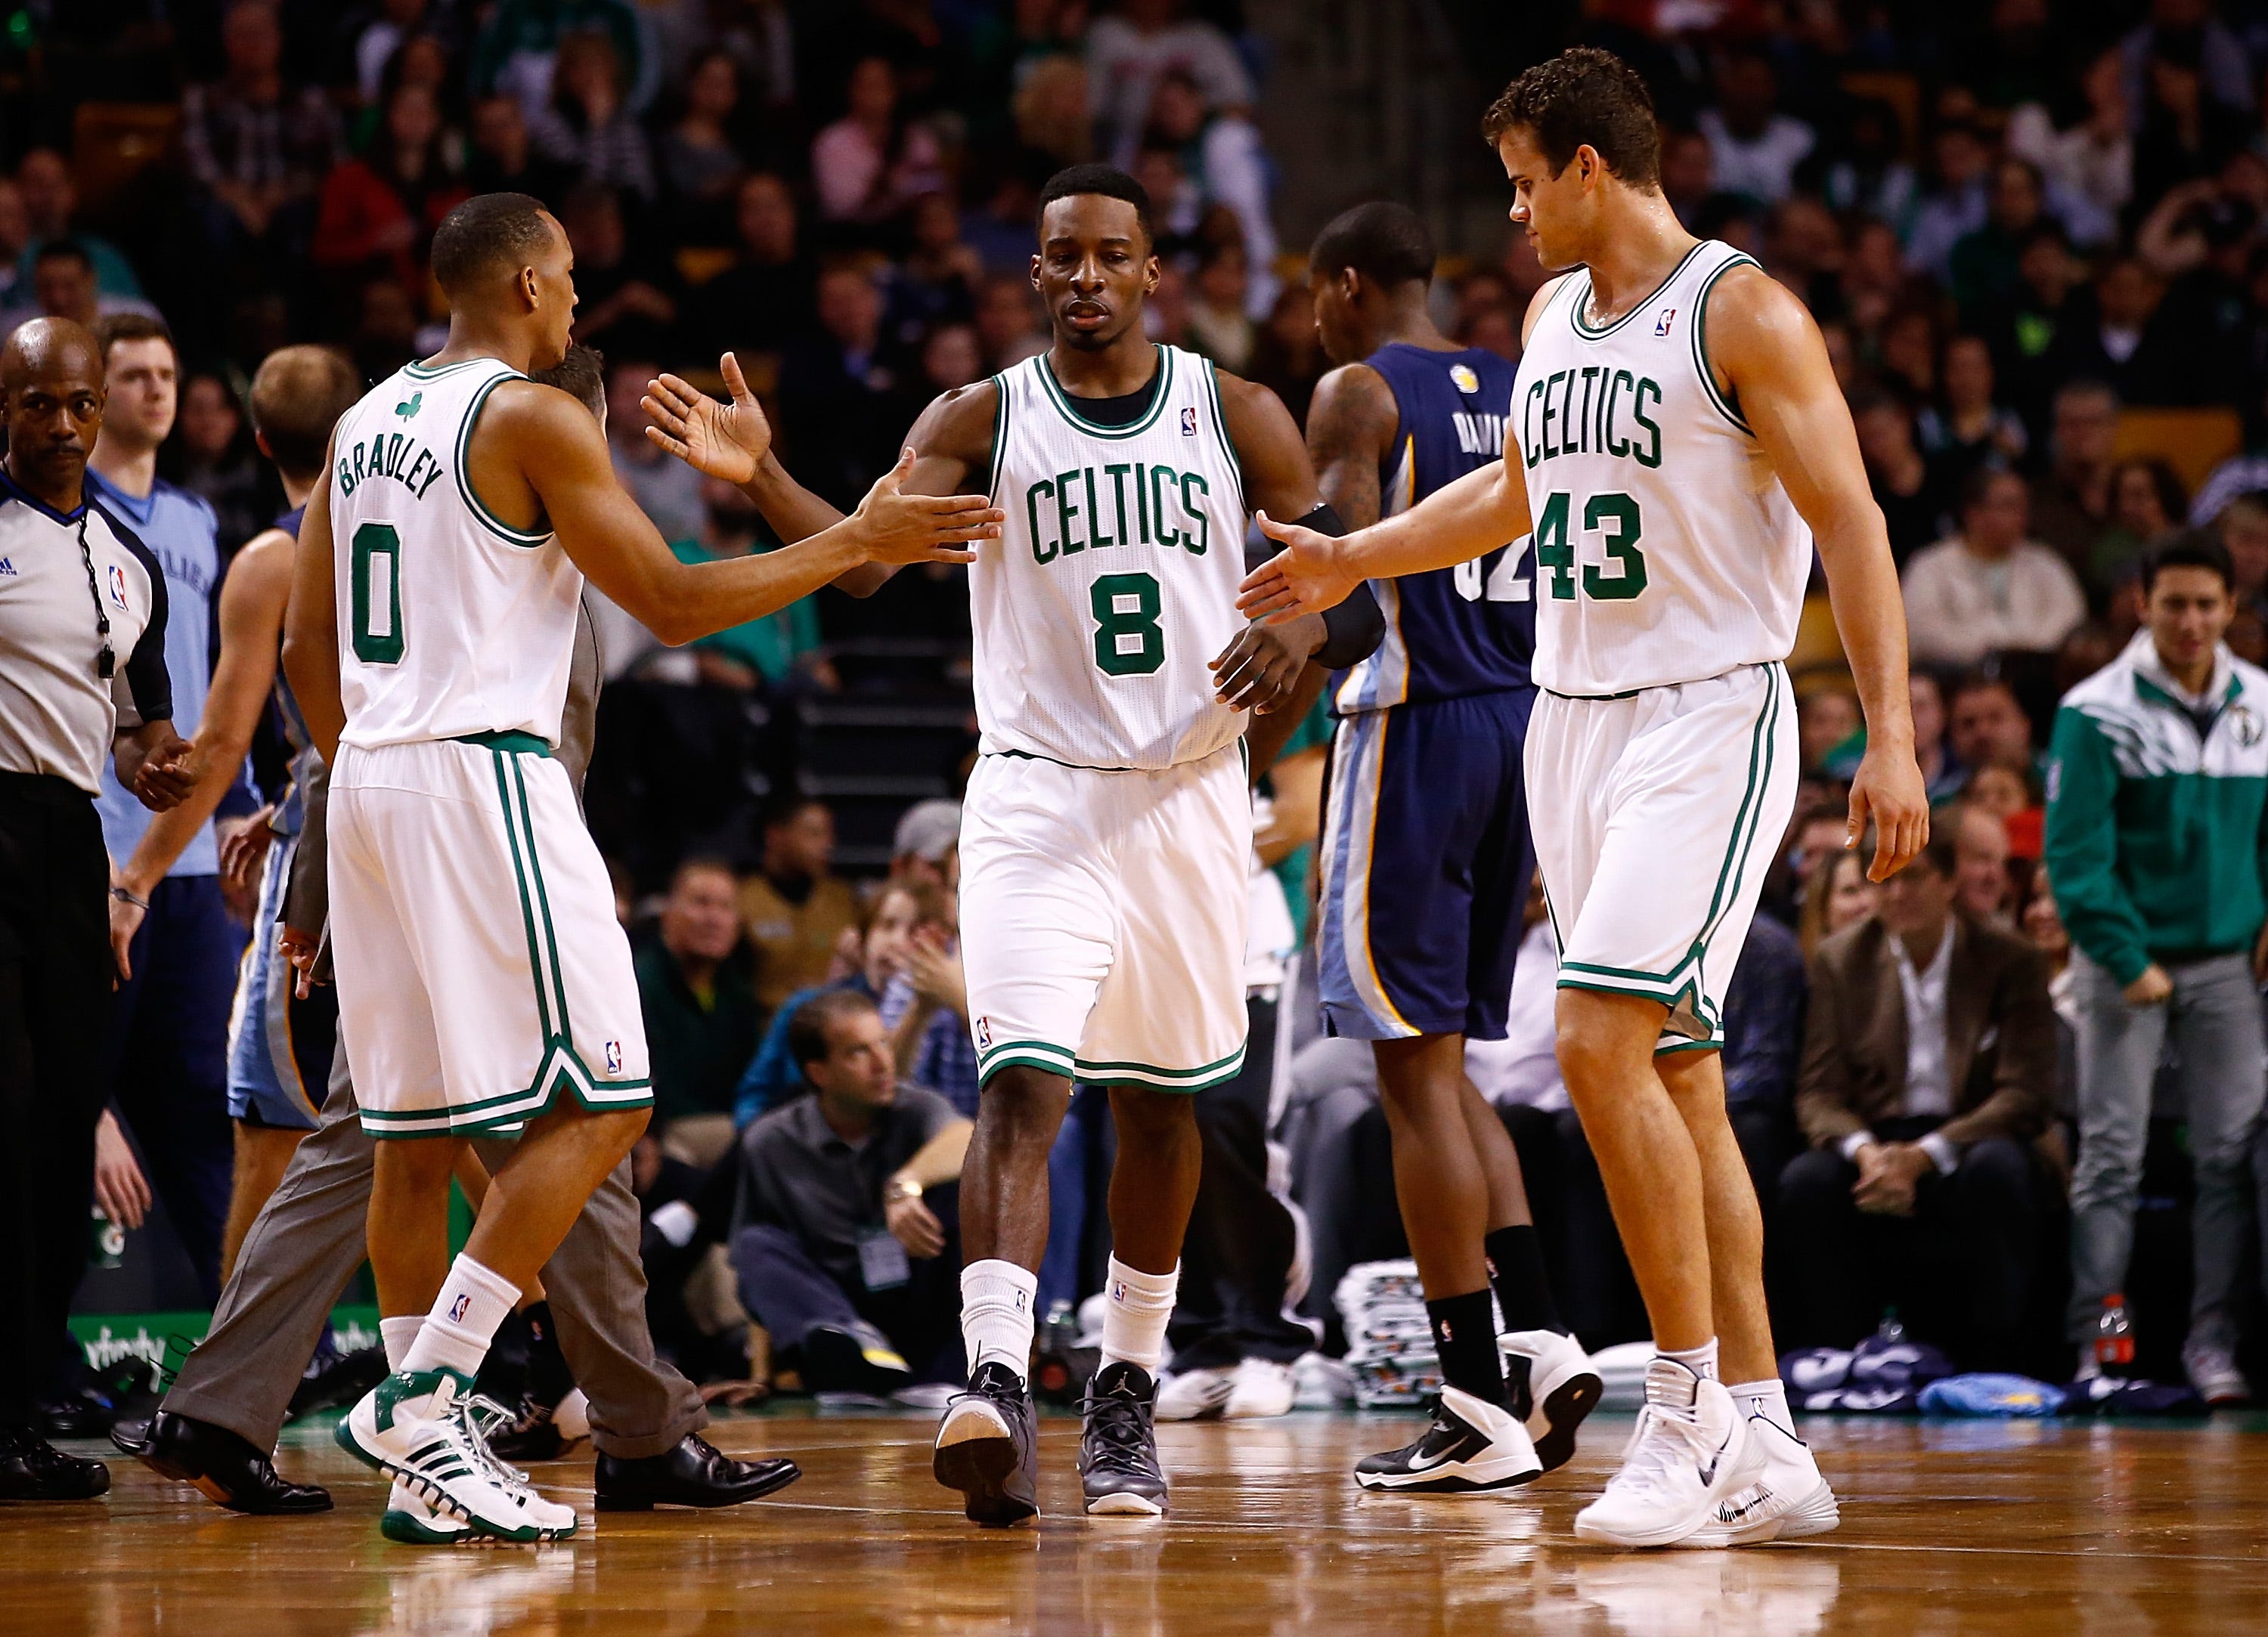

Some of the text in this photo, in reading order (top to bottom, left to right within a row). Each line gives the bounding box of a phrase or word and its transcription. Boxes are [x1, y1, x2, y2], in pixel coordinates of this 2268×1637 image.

[337, 432, 444, 501] BRADLEY
[1524, 366, 1662, 469] CELTICS
[1026, 463, 1210, 565] CELTICS
[1536, 490, 1648, 602] 43
[350, 518, 407, 668] 0
[1089, 571, 1166, 679] 8
